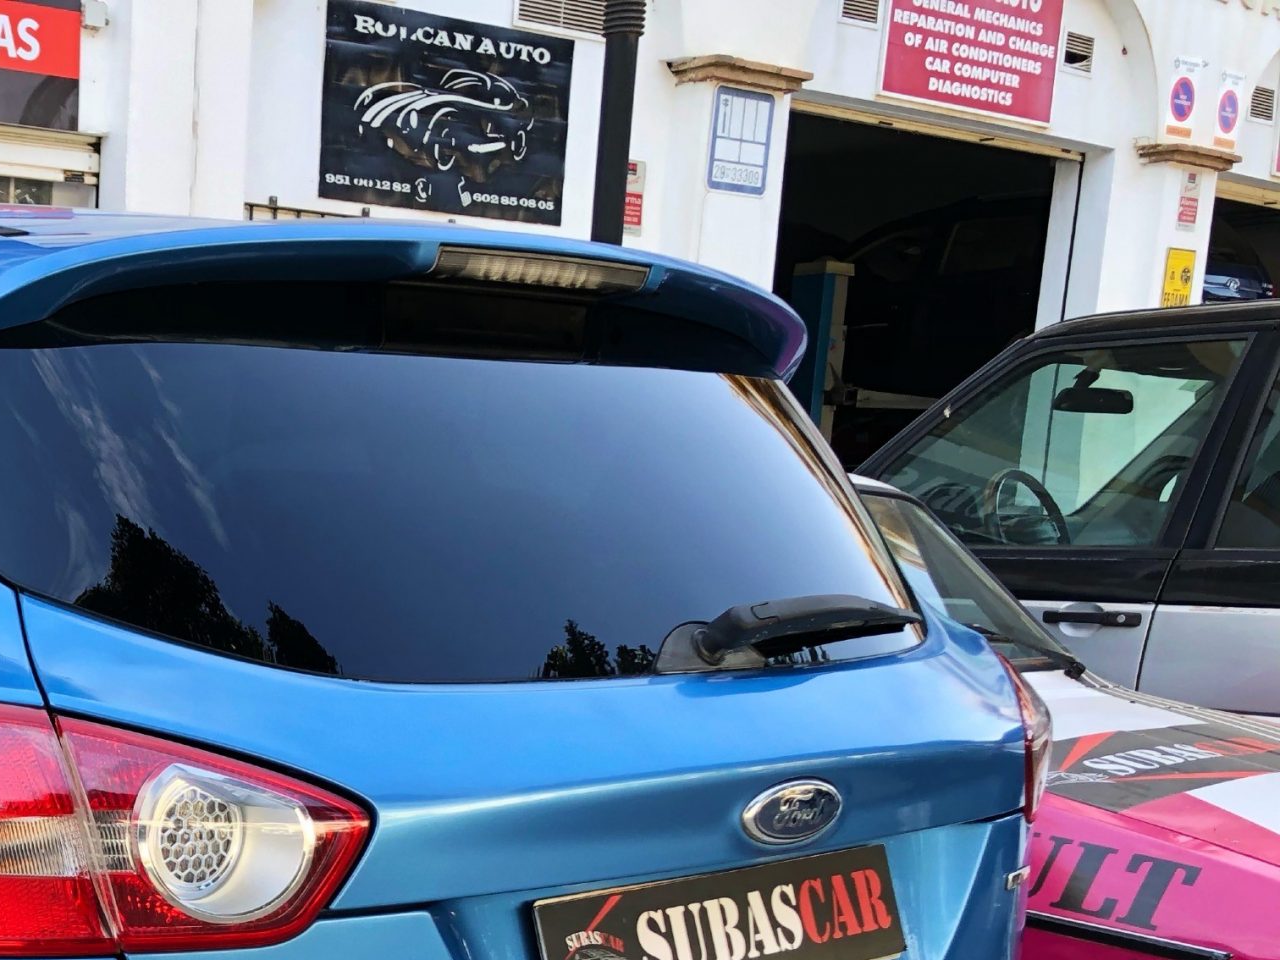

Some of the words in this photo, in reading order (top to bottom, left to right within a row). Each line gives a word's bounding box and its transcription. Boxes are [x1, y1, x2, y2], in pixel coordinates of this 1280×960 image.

[894, 9, 975, 39] REPARATION
[978, 29, 1006, 46] AND
[1009, 36, 1055, 58] CHARGE
[974, 7, 1043, 36] MECHANICS
[477, 37, 551, 65] AUTO
[904, 32, 923, 47] OF
[925, 37, 948, 54] AIR
[952, 42, 1042, 74] CONDITIONERS
[925, 56, 951, 73] CAR
[954, 62, 1020, 88] COMPUTER
[928, 77, 1013, 106] DIAGNOSTICS
[325, 173, 351, 186] 951
[392, 182, 411, 193] 82
[473, 192, 499, 204] 602
[500, 196, 518, 206] 85
[519, 198, 537, 208] 08
[538, 200, 555, 211] 05
[772, 791, 826, 831] Ford
